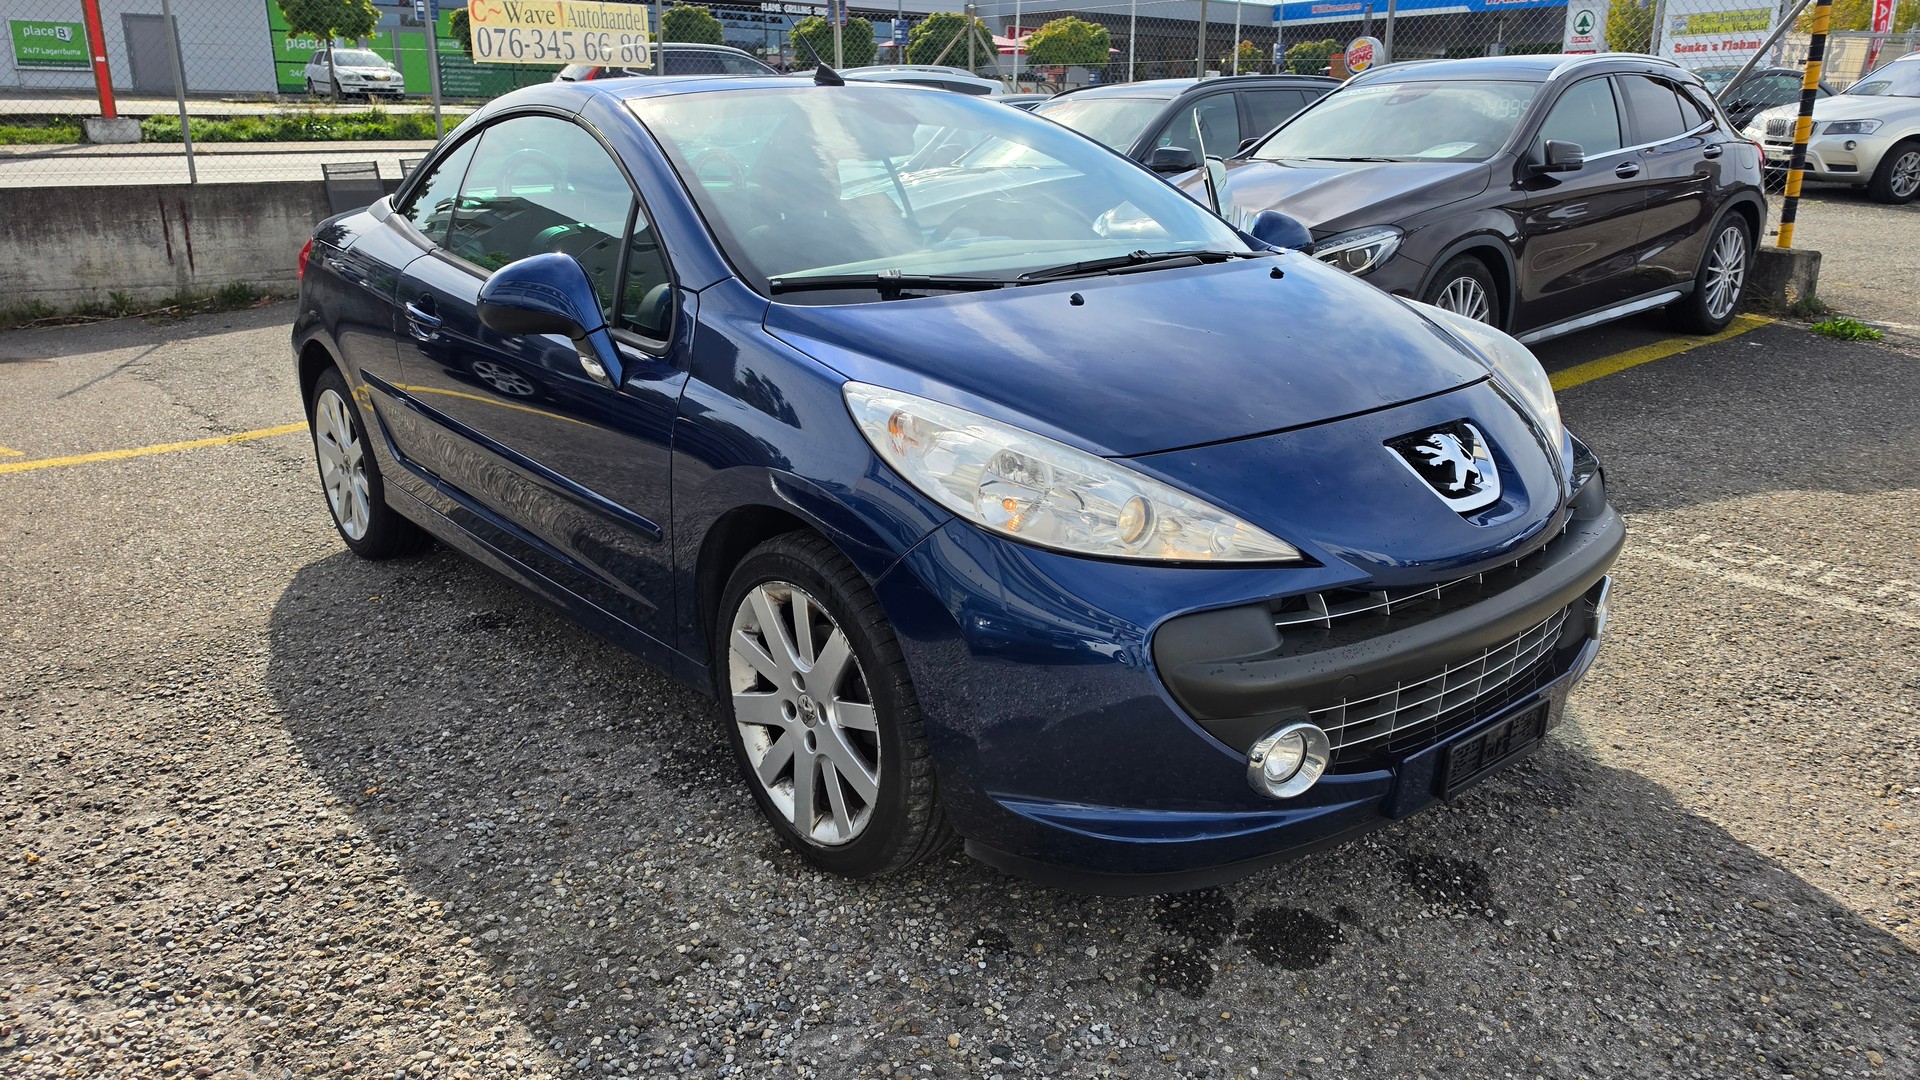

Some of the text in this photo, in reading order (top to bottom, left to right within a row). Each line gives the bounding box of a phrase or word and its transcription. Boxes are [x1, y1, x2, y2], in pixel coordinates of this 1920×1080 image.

[567, 5, 646, 31] Autohandel
[23, 25, 55, 37] place
[477, 26, 648, 63] 076-345 66 86
[1570, 36, 1595, 44] SPAR
[1348, 44, 1373, 58] BURGER
[1348, 51, 1374, 67] KING
[289, 69, 305, 77] 24/
